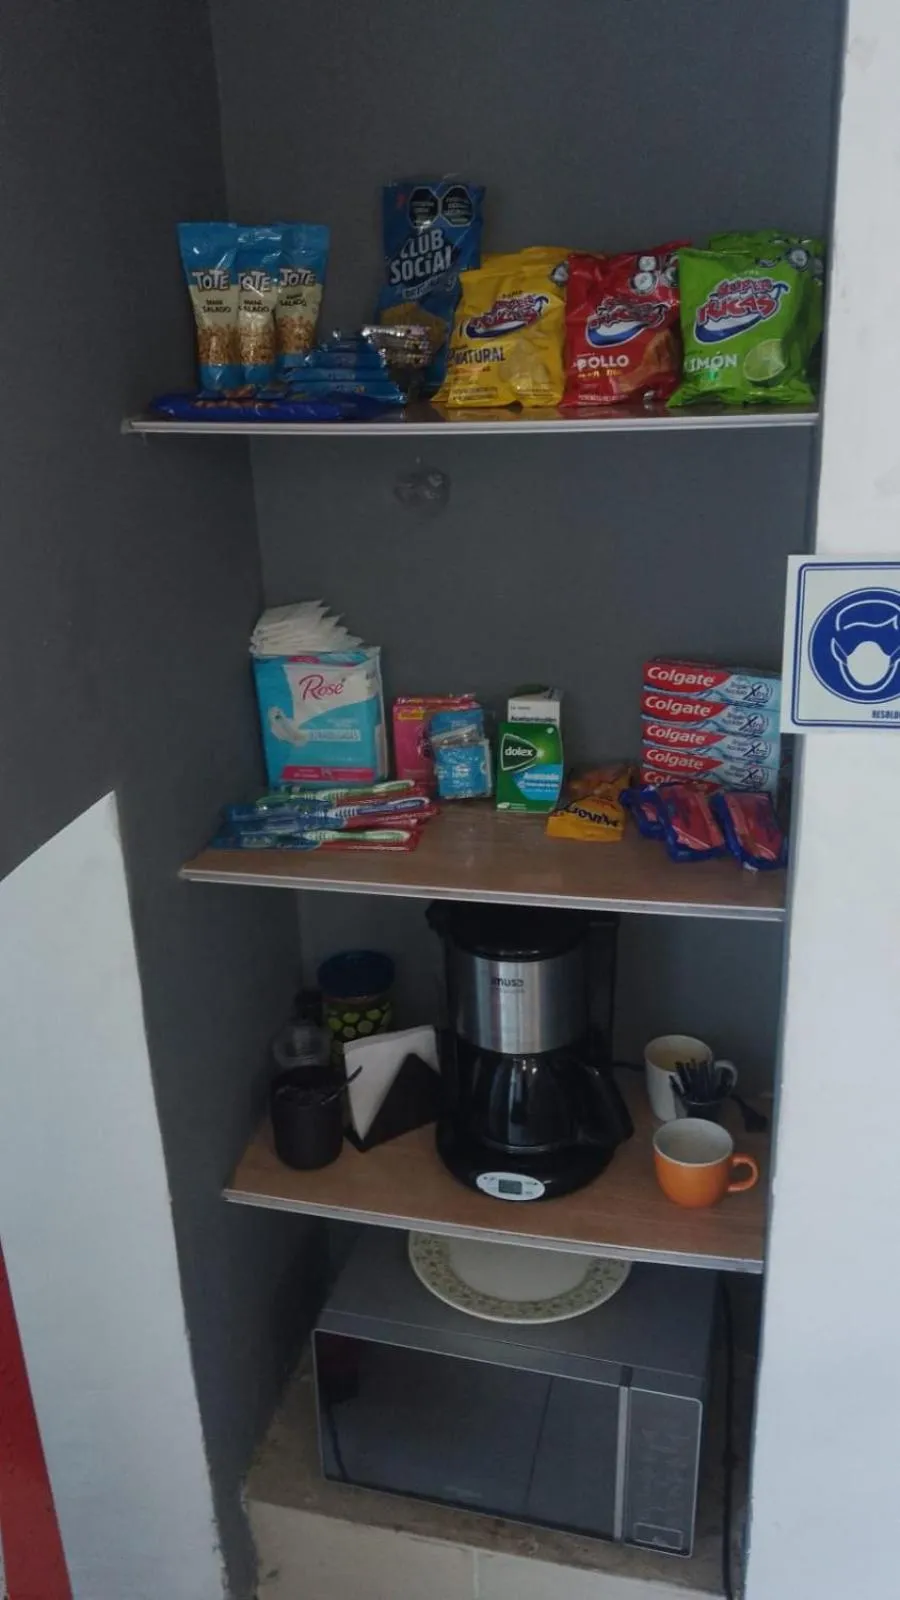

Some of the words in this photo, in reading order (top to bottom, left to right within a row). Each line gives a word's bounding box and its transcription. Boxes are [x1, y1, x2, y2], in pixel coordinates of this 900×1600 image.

[400, 229, 445, 259] CLUB
[192, 269, 231, 291] TOTE
[576, 354, 630, 373] POLLO
[647, 666, 715, 687] Colgate
[645, 695, 711, 717] Colgate
[871, 709, 900, 719] RESOLU
[646, 725, 706, 745] Colgate
[504, 746, 533, 757] dolex
[646, 749, 704, 770] Colgate
